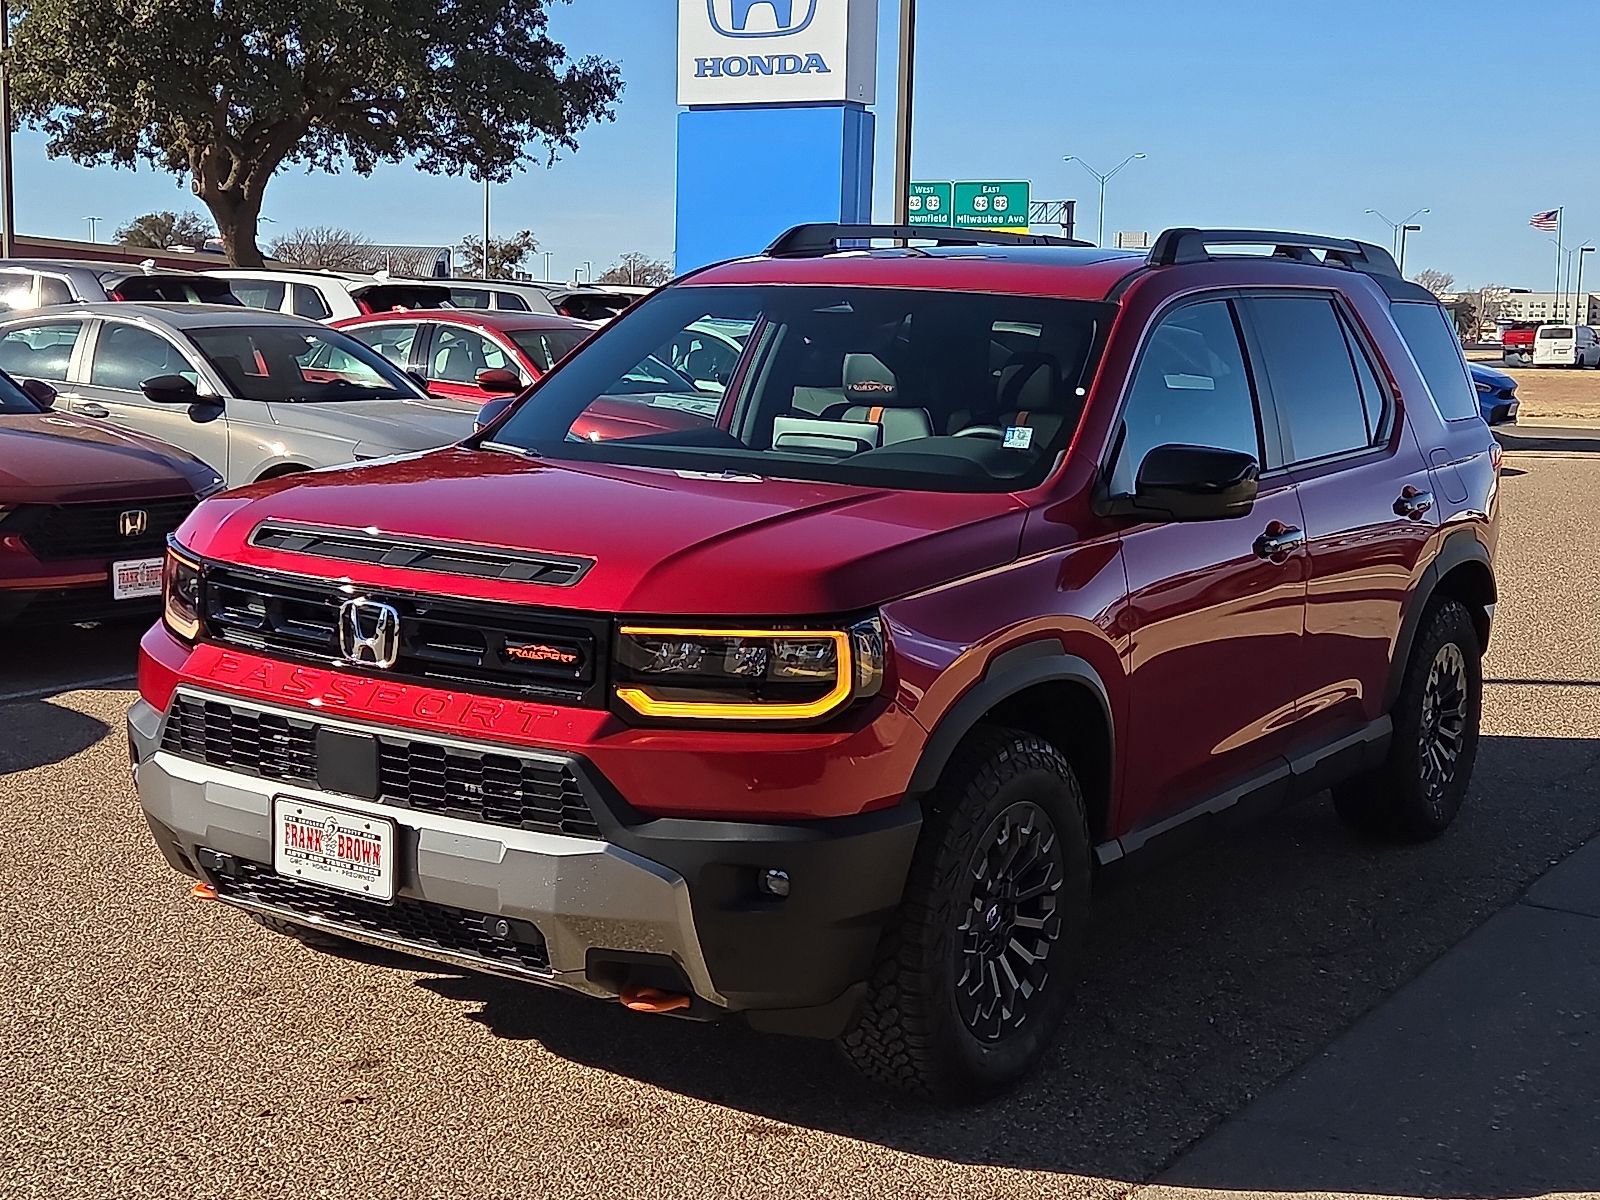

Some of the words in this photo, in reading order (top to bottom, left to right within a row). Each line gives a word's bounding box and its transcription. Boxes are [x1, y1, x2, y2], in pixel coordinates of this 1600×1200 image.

[694, 53, 831, 78] HONDA
[914, 186, 934, 194] WEST
[982, 185, 1000, 193] EAST
[910, 199, 920, 207] 62
[928, 199, 938, 207] 82
[976, 199, 986, 207] 62
[995, 199, 1006, 207] 82
[910, 214, 948, 223] ownfield
[957, 214, 1004, 223] Milwaukee
[1008, 215, 1025, 223] Ave
[505, 647, 577, 663] TRAILSPORT
[212, 653, 560, 733] PASSPORT
[285, 822, 324, 854] FRANK
[337, 834, 382, 868] BROWN
[286, 849, 307, 859] AUTO
[326, 858, 352, 869] TRUCK
